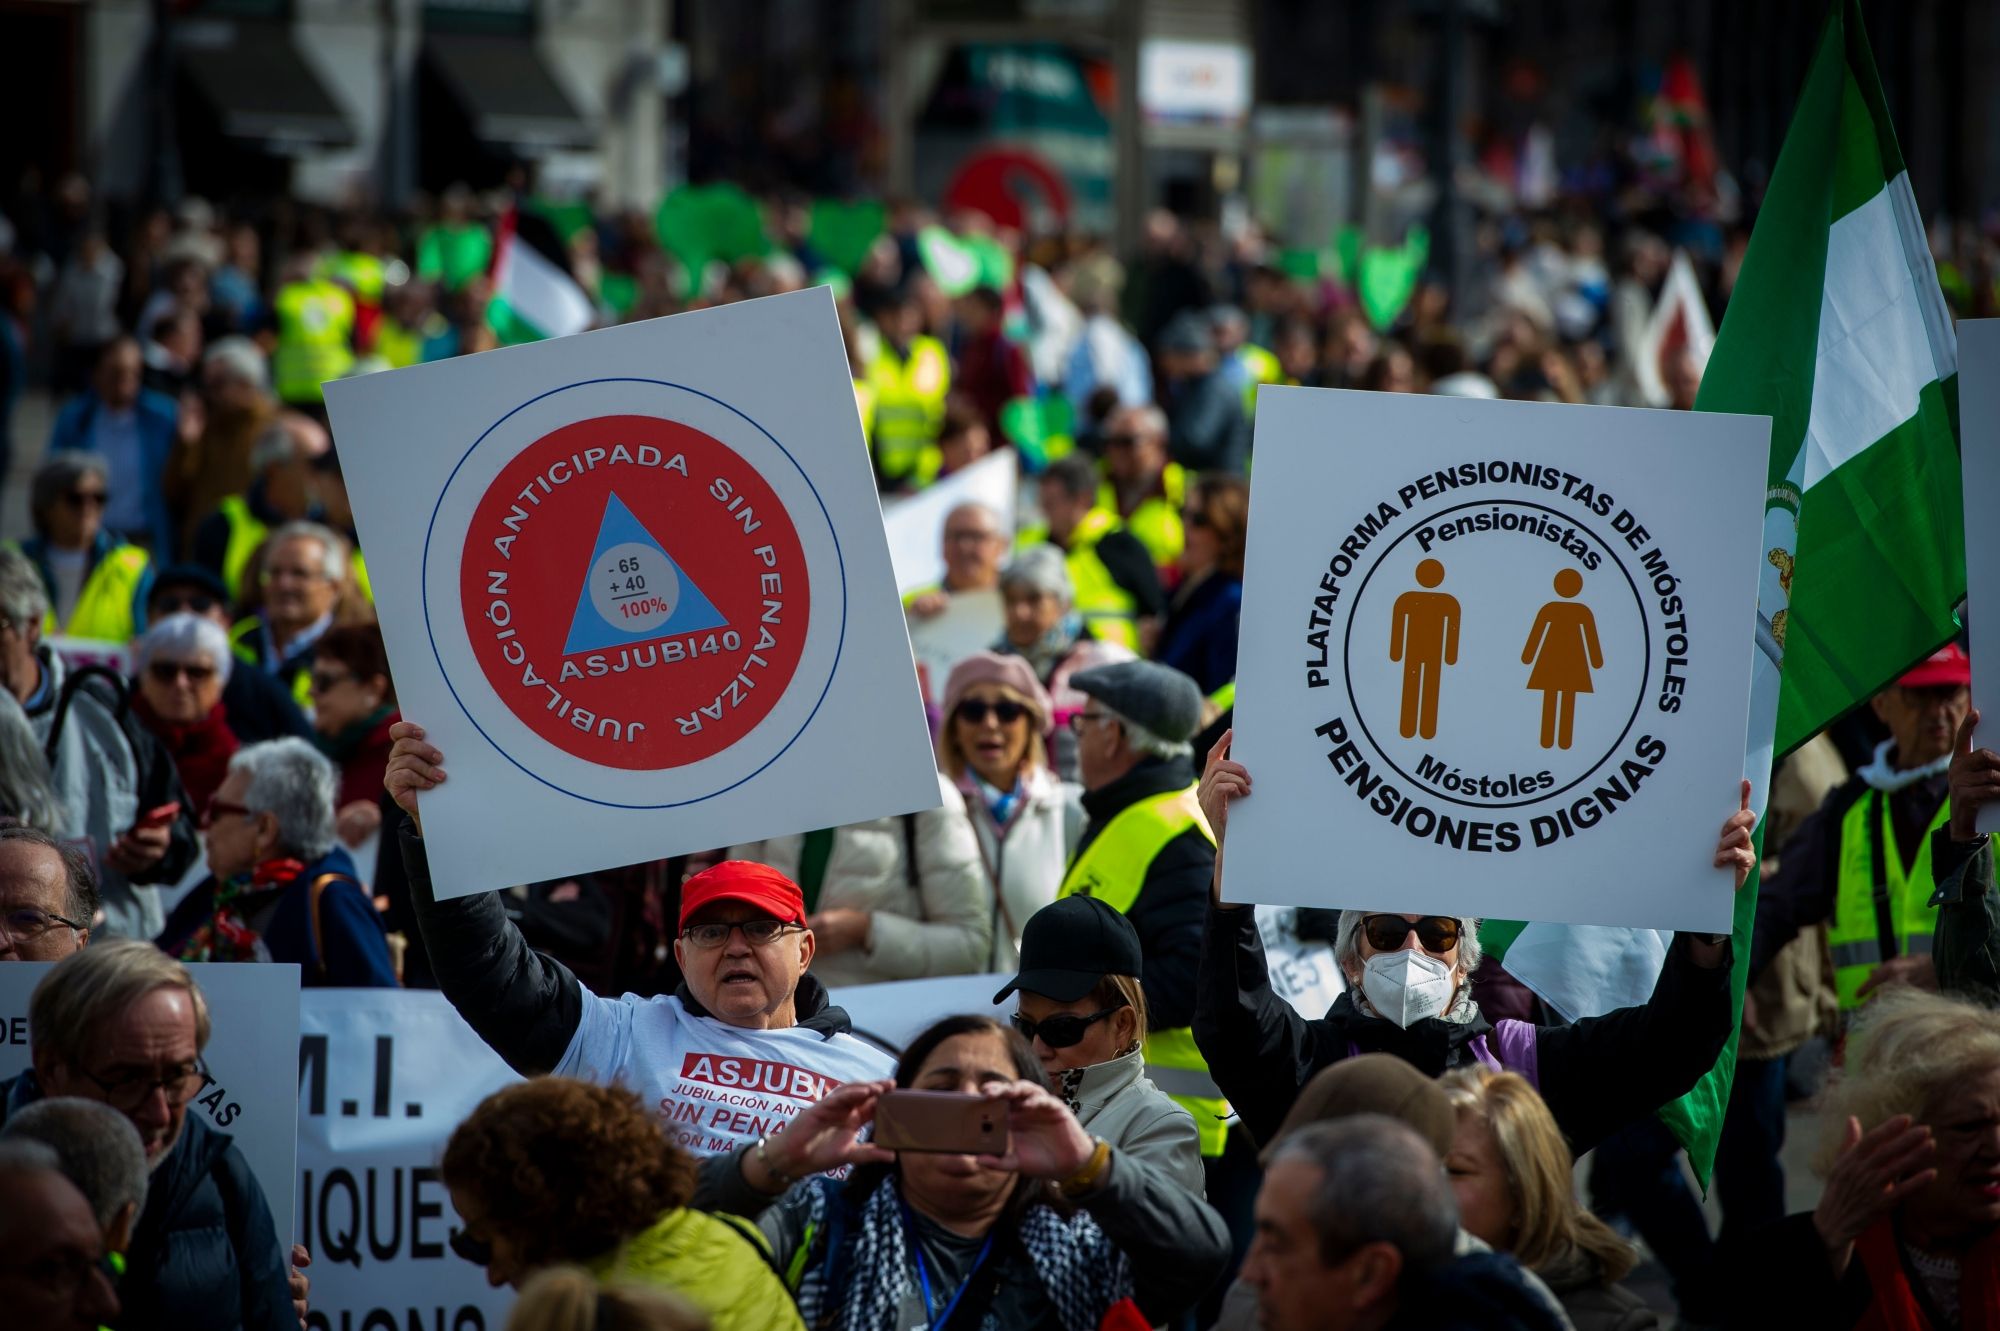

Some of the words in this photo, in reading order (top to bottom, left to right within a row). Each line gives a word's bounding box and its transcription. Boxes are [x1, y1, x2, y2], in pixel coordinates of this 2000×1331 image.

[492, 444, 690, 560] ANTICIPADA
[708, 477, 762, 535] SIN
[618, 556, 640, 573] 65
[1414, 506, 1603, 572] Pensionistas
[620, 596, 668, 619] 100%
[625, 575, 646, 591] 40
[1306, 501, 1402, 689] PLATAFORMA
[1397, 460, 1615, 518] PENSIONISTAS
[1610, 508, 1652, 552] DE
[1639, 547, 1690, 715] MÓSTOLES
[485, 570, 646, 743] JUBILACIÓN
[558, 630, 743, 684] ASJUBI40
[674, 544, 784, 738] PENALIZAR
[1314, 717, 1522, 853] PENSIONES
[1530, 734, 1668, 849] DIGNAS
[1415, 754, 1556, 800] Móstoles
[193, 1074, 242, 1128] TAS
[671, 1083, 770, 1111] JUBILACIÓN
[688, 1056, 828, 1102] ASJUBI
[656, 1098, 706, 1126] SIN
[709, 1108, 788, 1137] PENA
